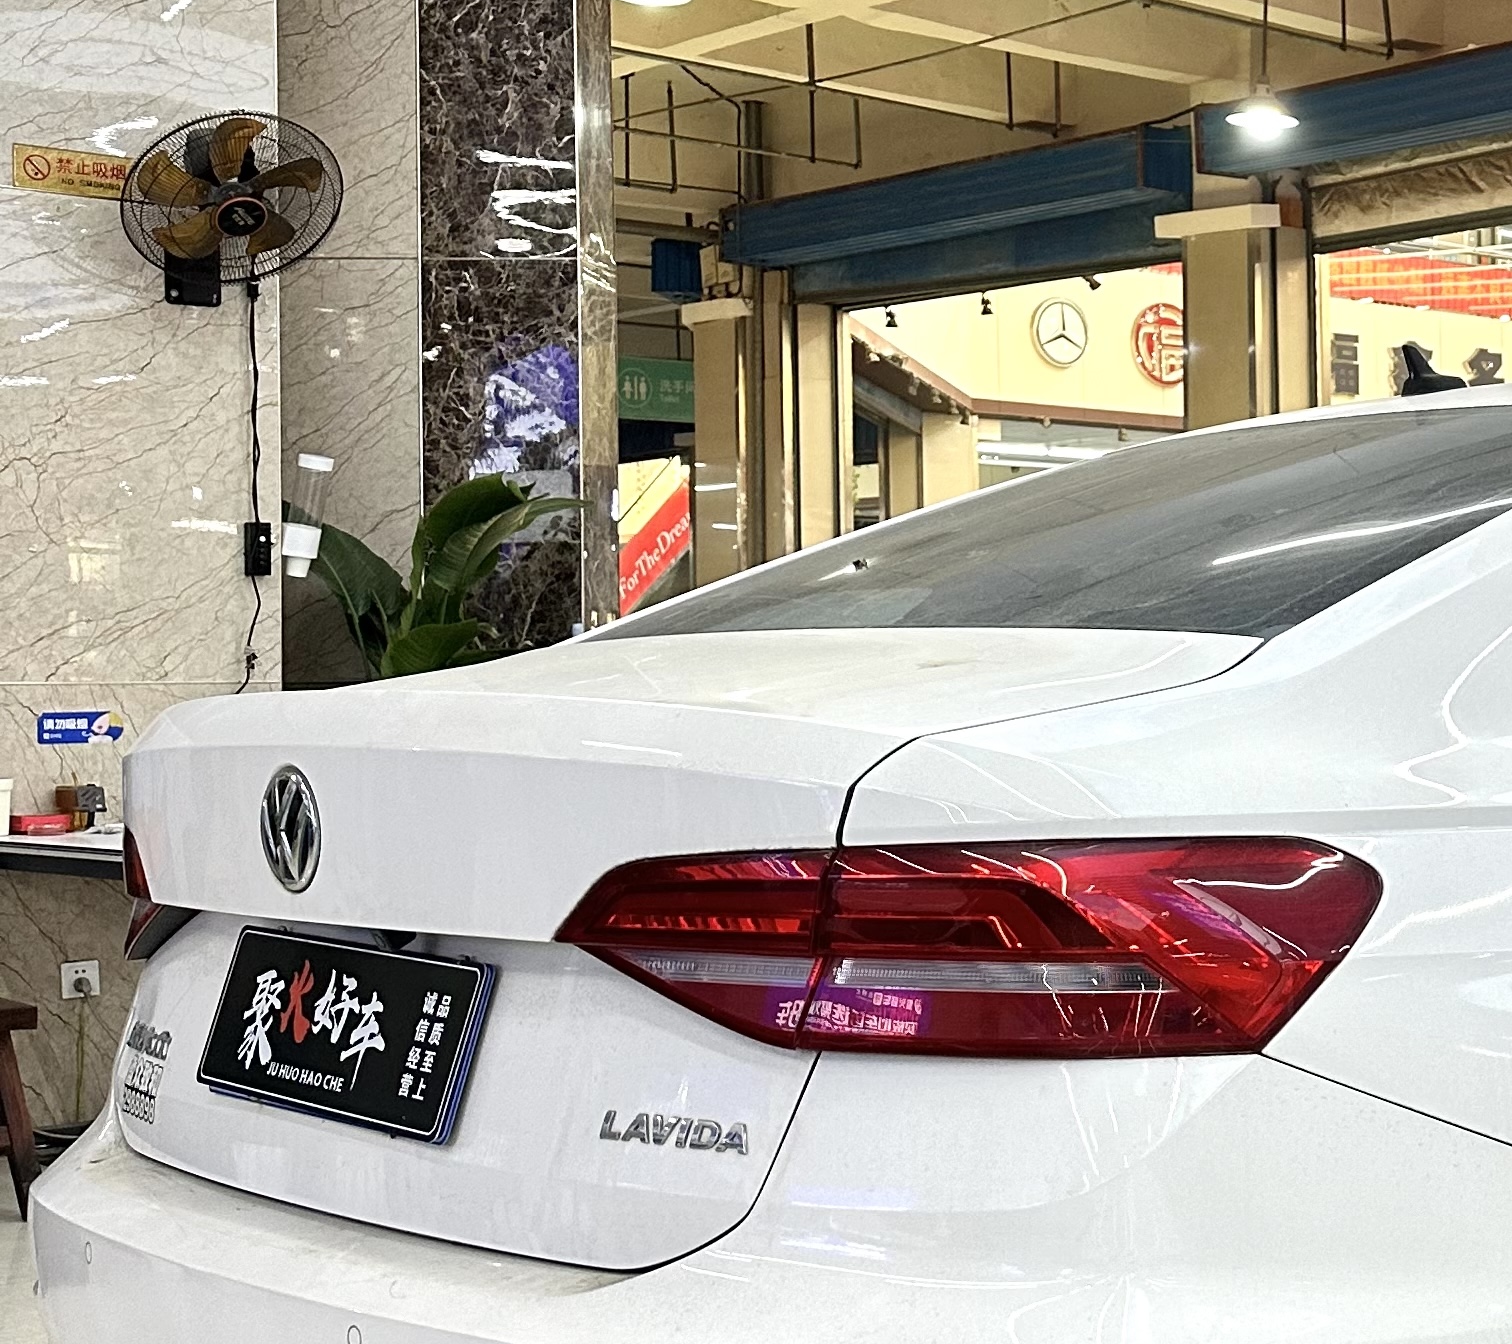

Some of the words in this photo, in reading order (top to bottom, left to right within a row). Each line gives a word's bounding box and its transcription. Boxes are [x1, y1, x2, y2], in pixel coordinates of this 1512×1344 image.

[56, 156, 127, 181] 禁止吸烟
[266, 1061, 280, 1077] JU
[277, 1063, 300, 1081] HUO
[298, 1068, 323, 1087] HAO
[322, 1074, 345, 1093] CHE
[599, 1109, 749, 1156] LAVIDA
